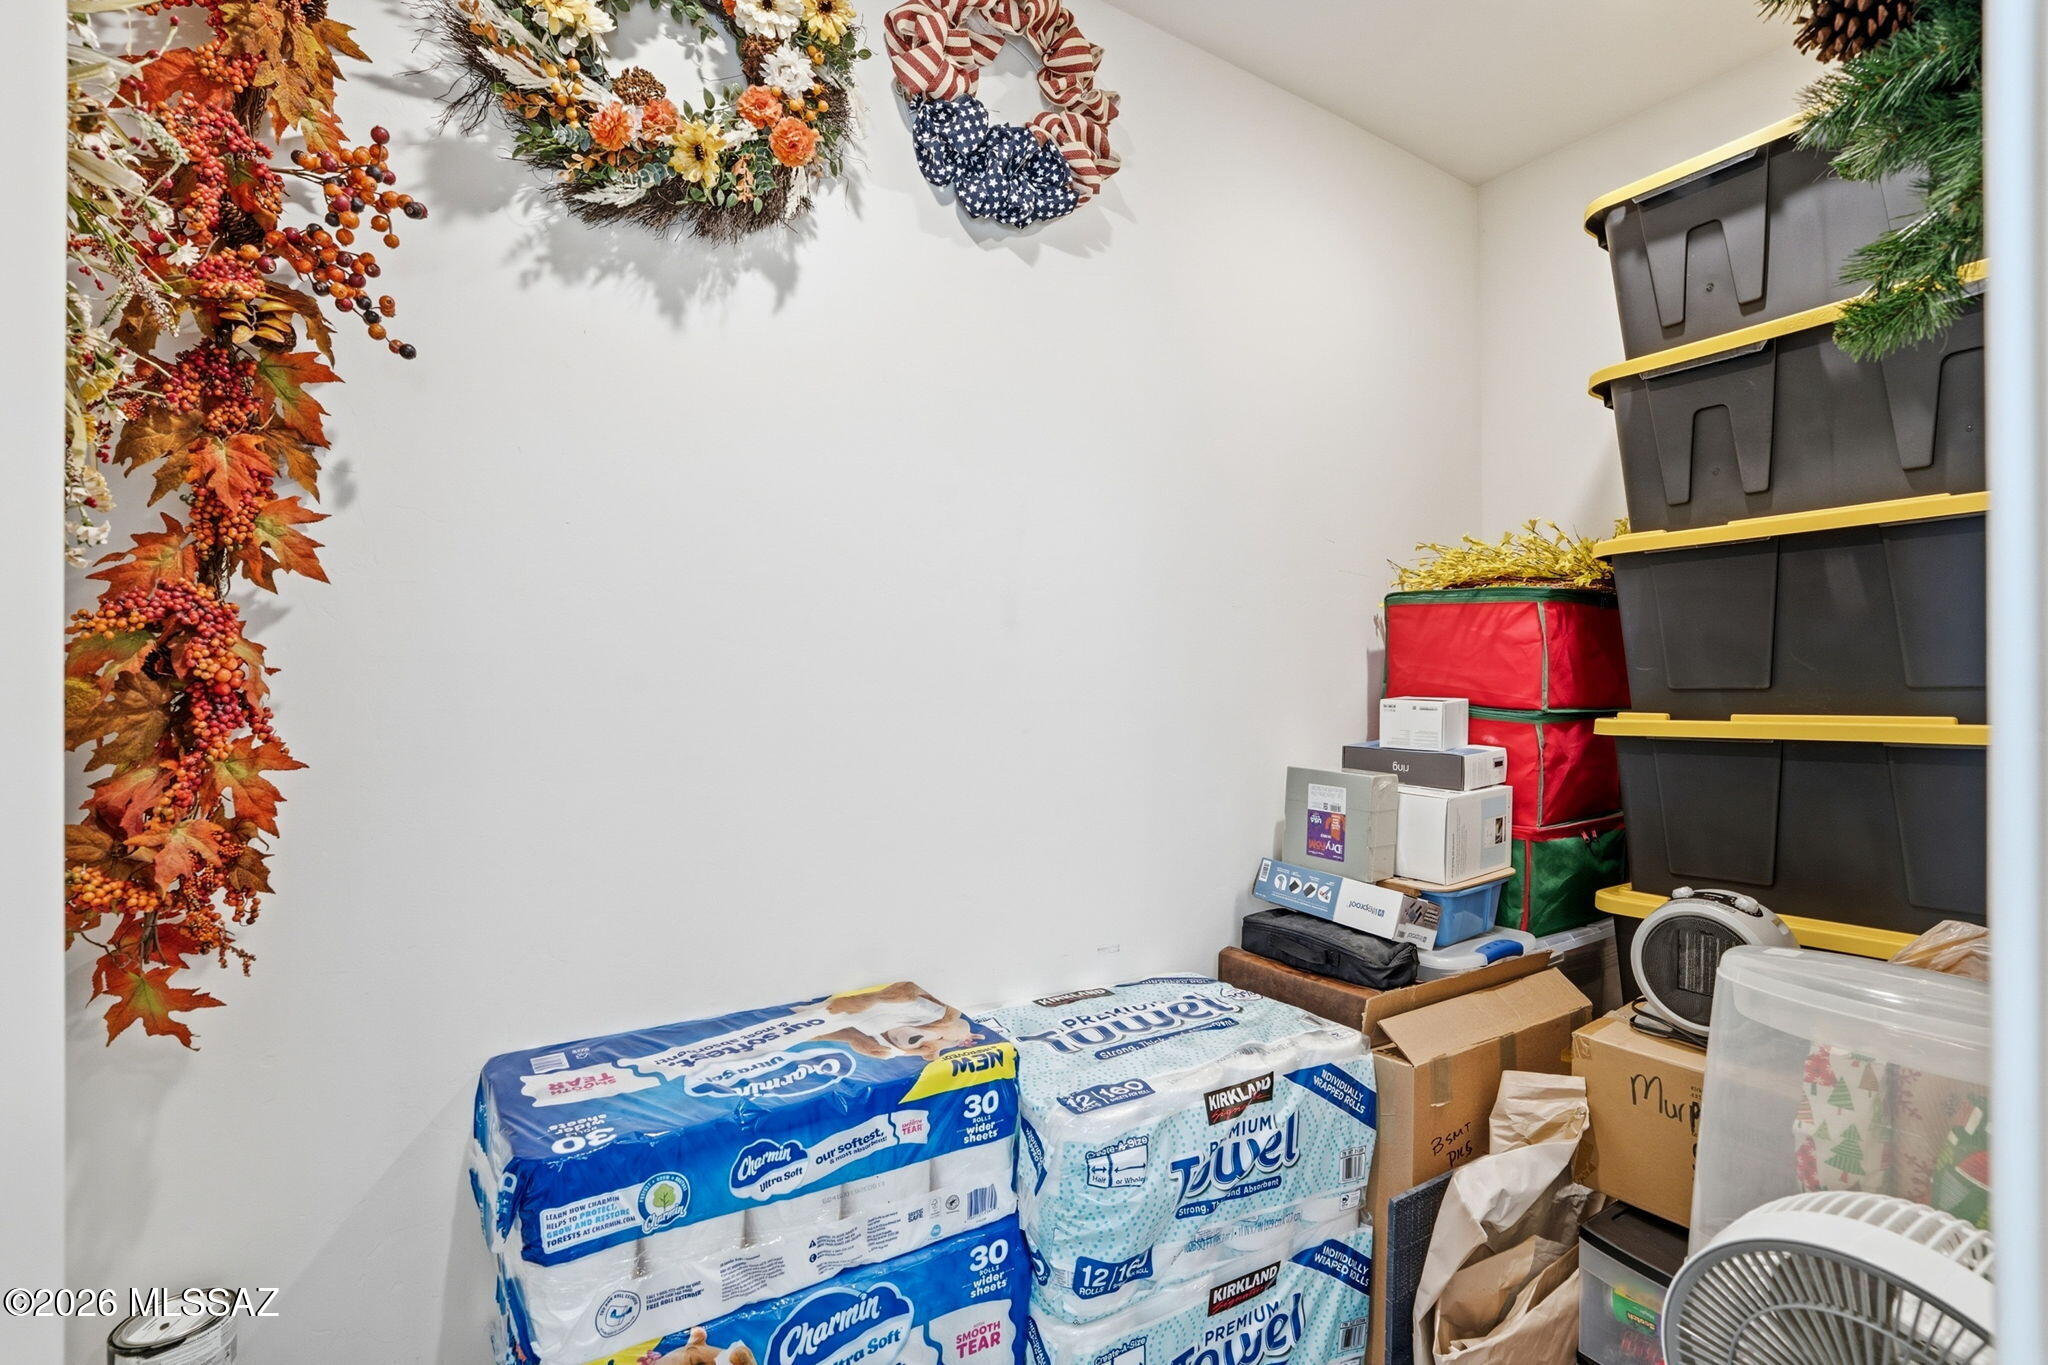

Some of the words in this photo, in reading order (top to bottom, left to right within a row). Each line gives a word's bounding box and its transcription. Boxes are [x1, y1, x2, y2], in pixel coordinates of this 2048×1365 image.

[1392, 760, 1410, 773] ring
[1348, 900, 1378, 917] lifeproof
[1038, 988, 1106, 1006] KIRKLAND
[742, 1025, 776, 1039] most
[783, 1018, 825, 1036] our
[1016, 995, 1241, 1053] Towel
[736, 1055, 785, 1075] Ultra
[952, 1049, 1004, 1077] NEW
[548, 1072, 615, 1091] TEAR
[550, 1077, 617, 1096] SMOOTH
[1209, 1076, 1272, 1111] KIRKLAND
[963, 1089, 1000, 1119] 30
[1313, 1075, 1344, 1101] WRAPPED
[1343, 1096, 1366, 1114] ROLLS
[902, 1124, 922, 1135] TEAR
[966, 1121, 996, 1135] wider
[972, 1115, 991, 1123] ROLLS
[551, 1127, 617, 1154] 30
[815, 1148, 836, 1165] our
[837, 1127, 885, 1154] softest,
[963, 1129, 998, 1144] sheets
[737, 1146, 792, 1181] Charmin
[835, 1151, 852, 1163] most
[1169, 1111, 1300, 1197] Towel
[759, 1175, 783, 1193] Ultra
[783, 1167, 803, 1181] Soft
[1092, 1175, 1106, 1184] Half
[1124, 1176, 1146, 1185] Whole
[1243, 1178, 1280, 1194] Absorbent
[545, 1210, 567, 1221] LEARN
[569, 1204, 586, 1216] HOW
[588, 1195, 620, 1209] CHARMIN
[546, 1219, 567, 1230] HELPS
[568, 1215, 578, 1224] TO
[579, 1203, 618, 1220] PROTECT,
[643, 1203, 685, 1232] Charmin
[1178, 1203, 1210, 1217] Strong,
[546, 1226, 572, 1239] GROW
[574, 1219, 593, 1230] AND
[595, 1208, 630, 1224] RESTORE
[547, 1231, 581, 1248] FORESTS
[583, 1227, 591, 1236] AT
[591, 1215, 636, 1233] CHARMIN.COM
[969, 1239, 1009, 1272] 30
[972, 1271, 1004, 1289] wider
[979, 1266, 999, 1276] ROLLS
[1082, 1264, 1107, 1288] 12
[970, 1281, 1007, 1298] sheets
[1079, 1286, 1104, 1296] ROLLS
[1213, 1265, 1279, 1305] KIRKLAND
[779, 1293, 881, 1365] Charmin
[955, 1320, 1001, 1345] SMOOTH
[1205, 1300, 1280, 1347] PREMIUM
[867, 1328, 901, 1355] Soft
[956, 1333, 1001, 1359] TEAR
